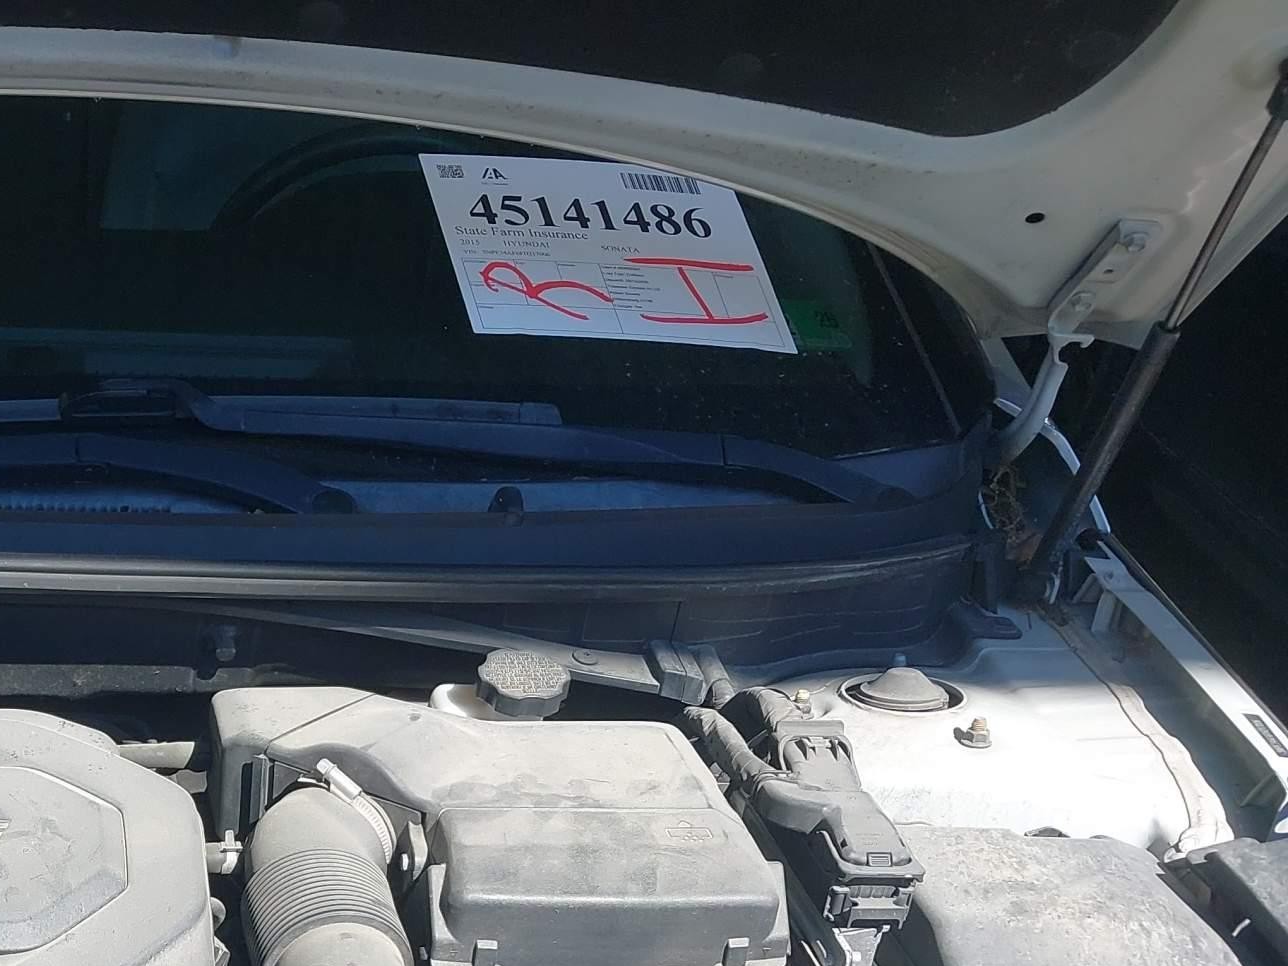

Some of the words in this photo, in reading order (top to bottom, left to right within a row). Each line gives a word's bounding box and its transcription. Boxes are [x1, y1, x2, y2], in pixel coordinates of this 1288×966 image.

[469, 193, 712, 238] 45141486
[454, 225, 487, 236] State
[491, 227, 525, 237] Farm
[529, 227, 589, 240] Insurance
[503, 240, 551, 249] HYUNDAI
[600, 245, 641, 254] SONATA
